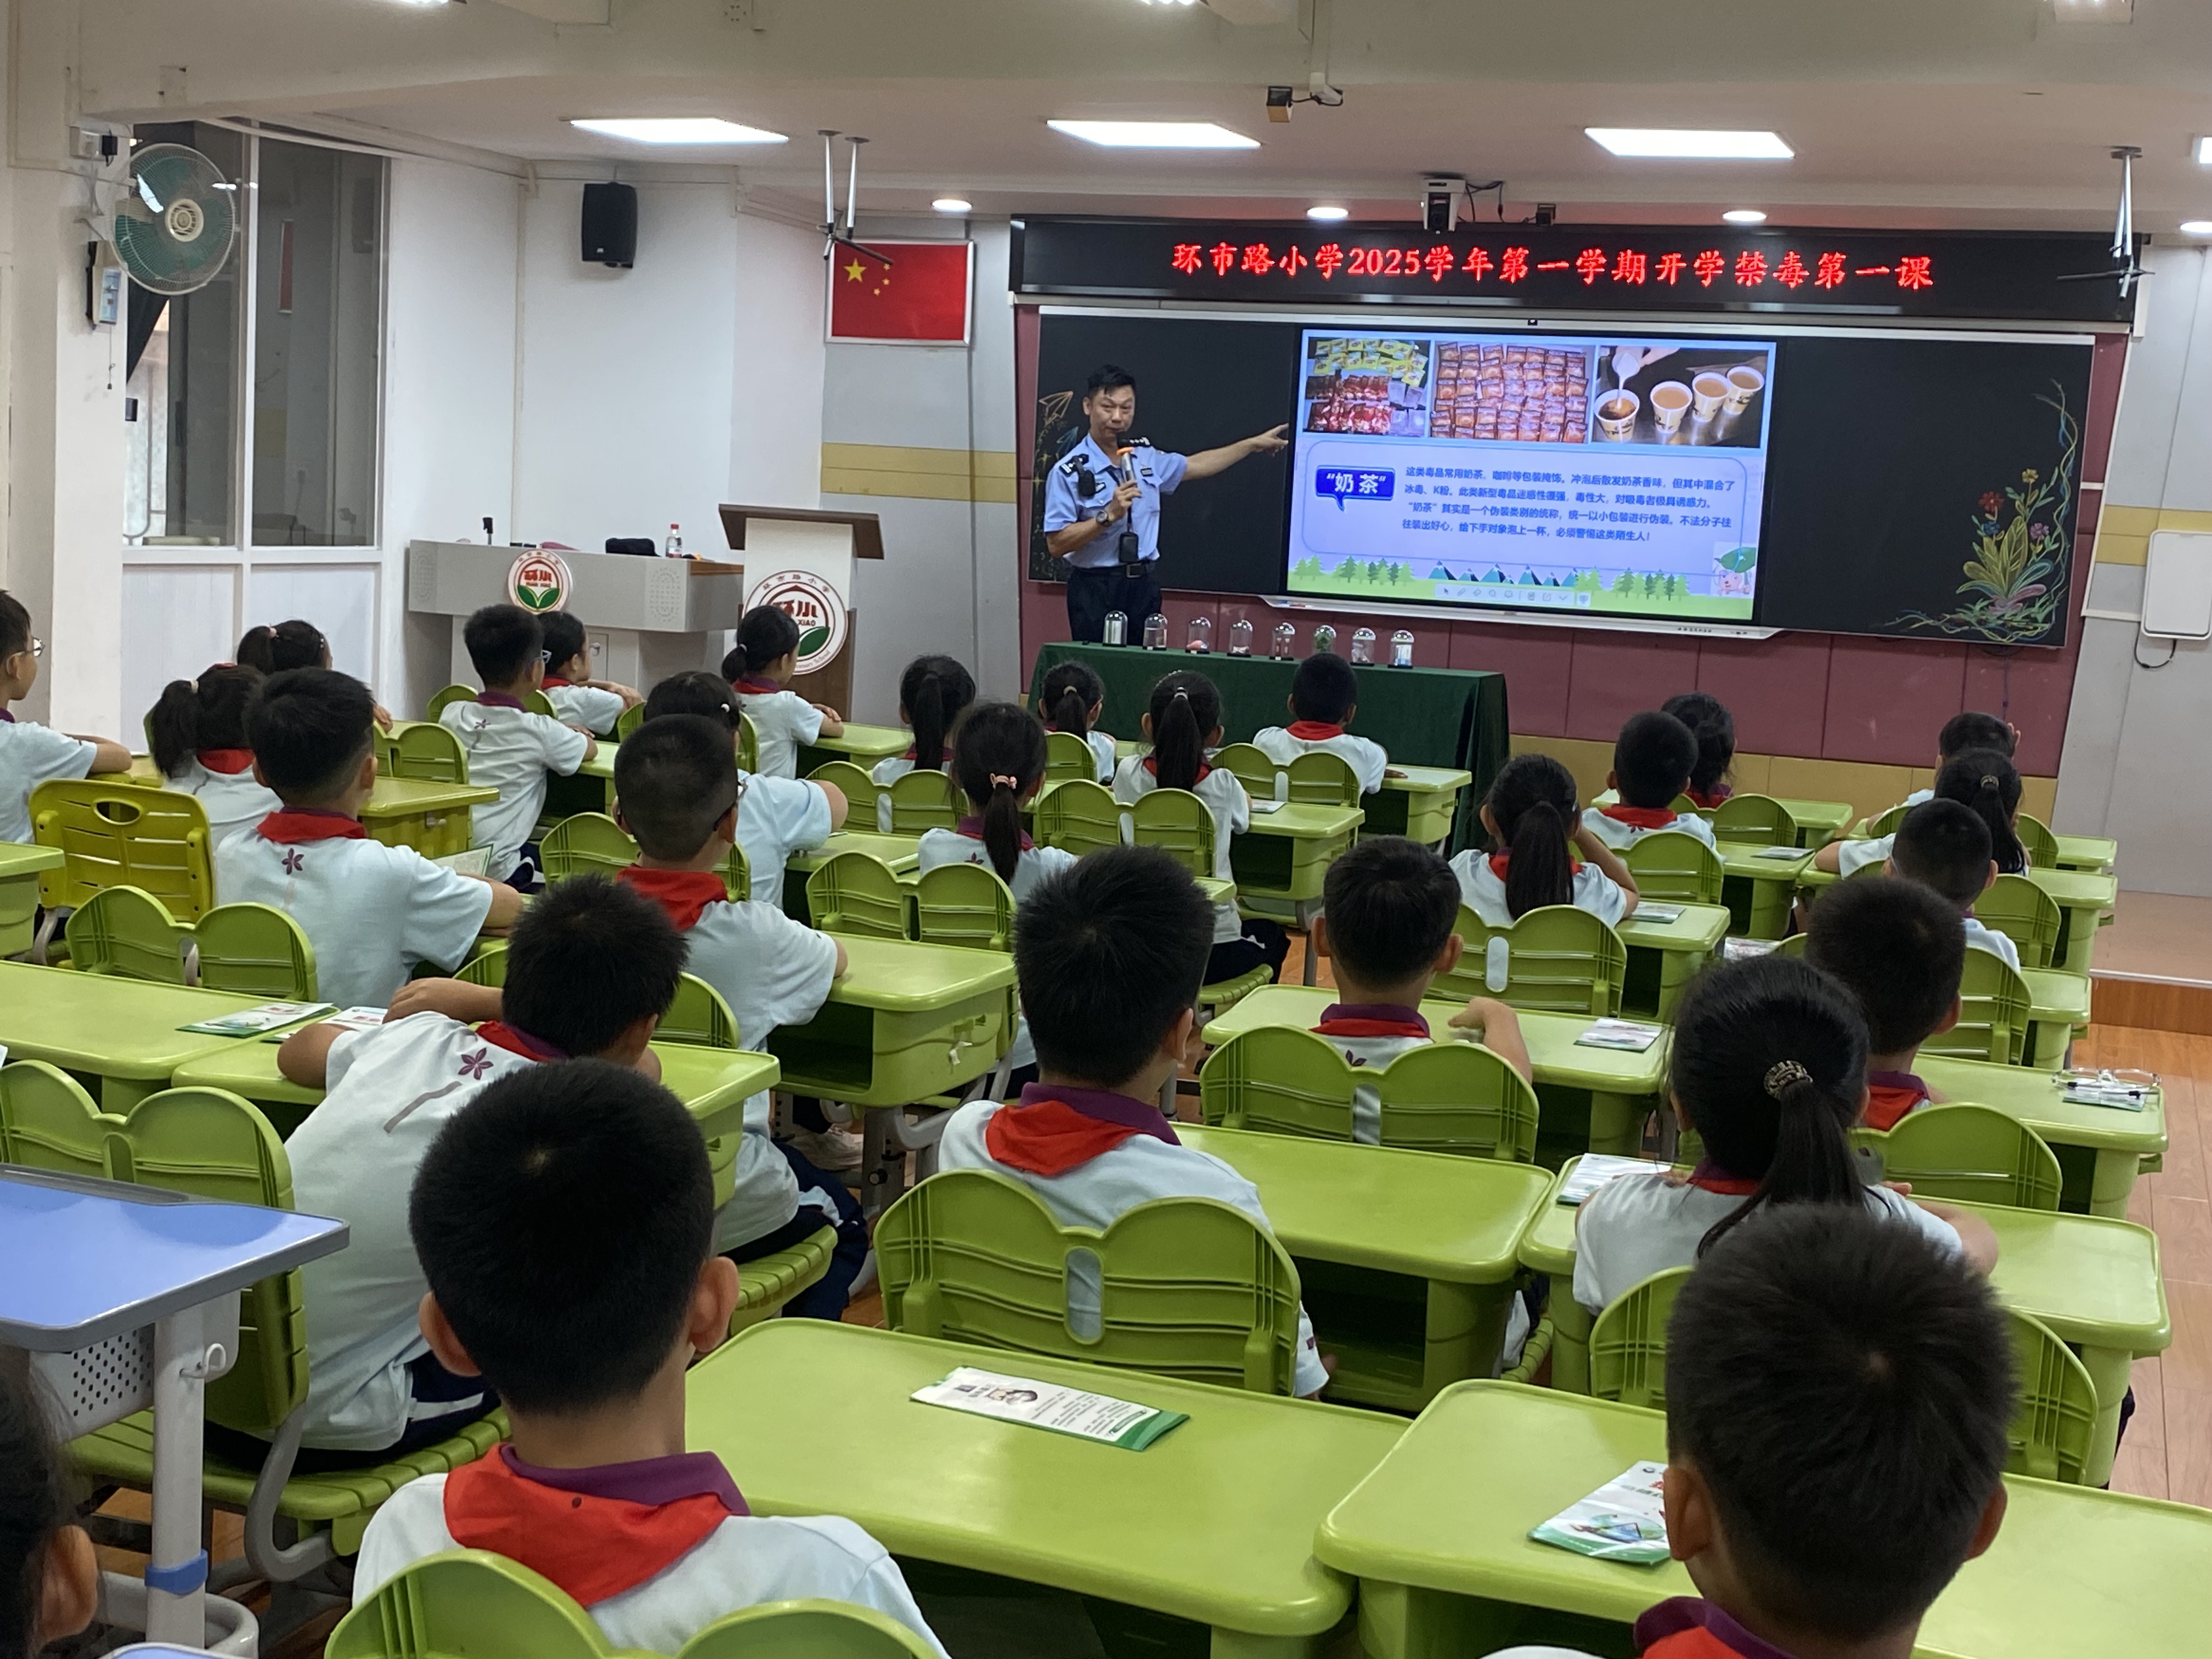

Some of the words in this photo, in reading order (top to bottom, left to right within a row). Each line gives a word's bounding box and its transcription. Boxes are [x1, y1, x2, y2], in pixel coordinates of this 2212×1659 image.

[1171, 241, 1934, 290] 环市路小学2025学年第一学期开学禁毒第一课
